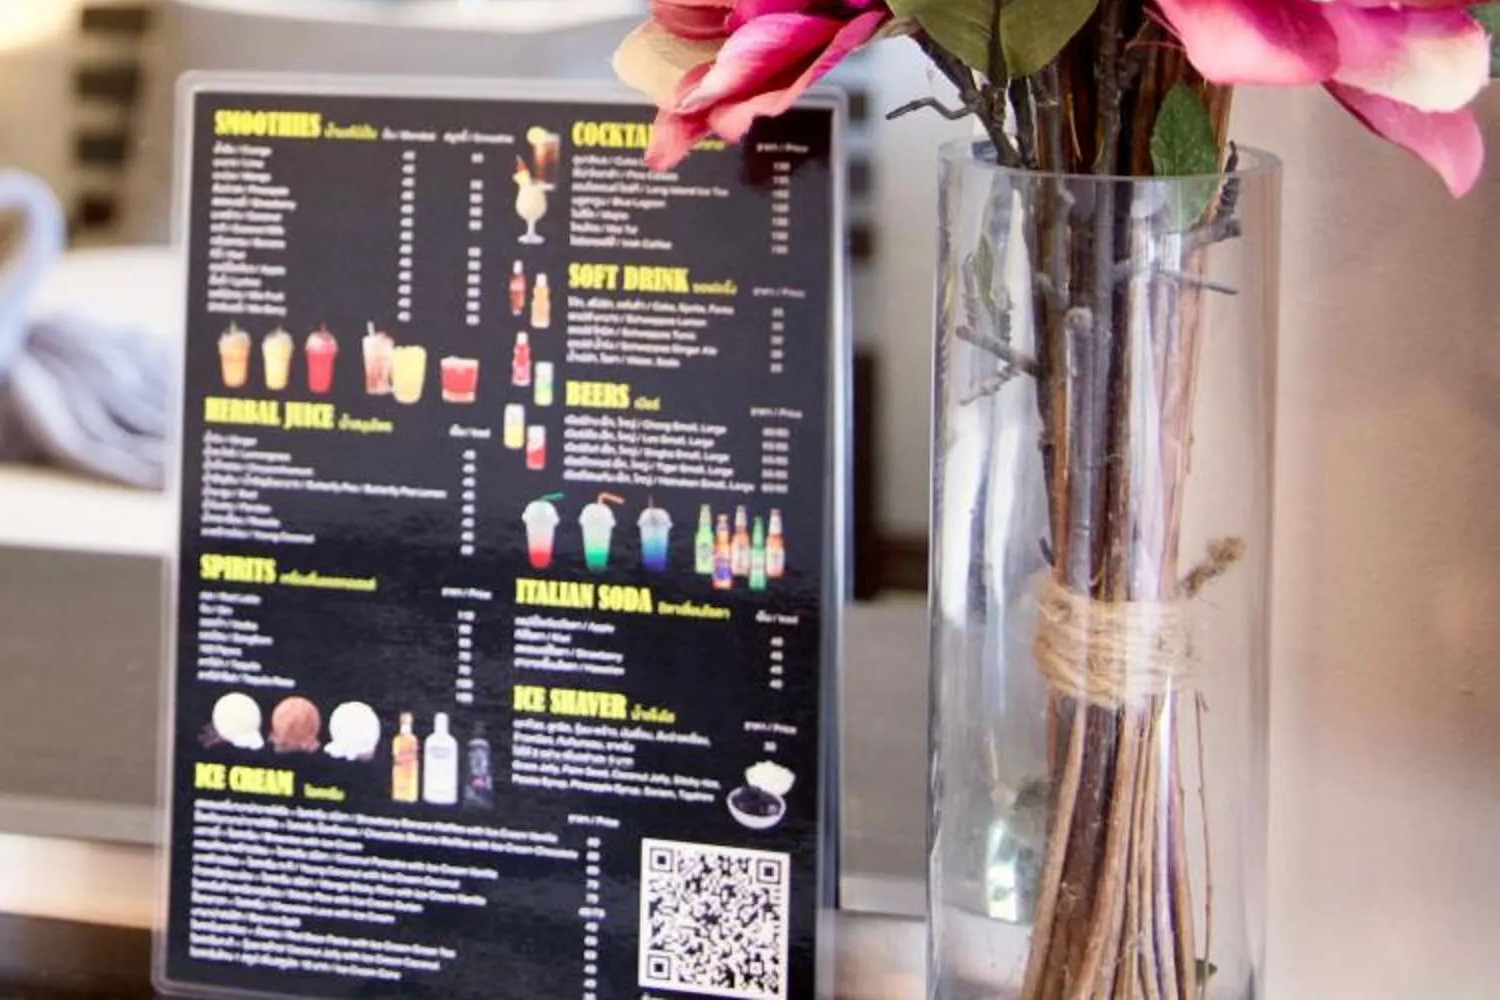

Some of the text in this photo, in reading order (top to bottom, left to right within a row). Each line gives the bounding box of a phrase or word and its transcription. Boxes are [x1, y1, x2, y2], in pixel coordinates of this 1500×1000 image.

[213, 109, 322, 138] SMOOTHIES
[571, 121, 654, 149] COCKTA
[569, 263, 619, 290] SOFT
[623, 265, 690, 293] DRINK
[565, 380, 630, 408] BEERS
[203, 397, 281, 426] HERBAL
[282, 401, 335, 429] JUICE
[200, 553, 277, 584] SPIRITS
[515, 578, 594, 609] ITALIAN
[598, 584, 653, 613] SODA
[513, 685, 547, 712] ICE
[549, 688, 627, 720] SHAVER
[195, 762, 227, 790] ICE
[228, 765, 294, 796] CREAM
